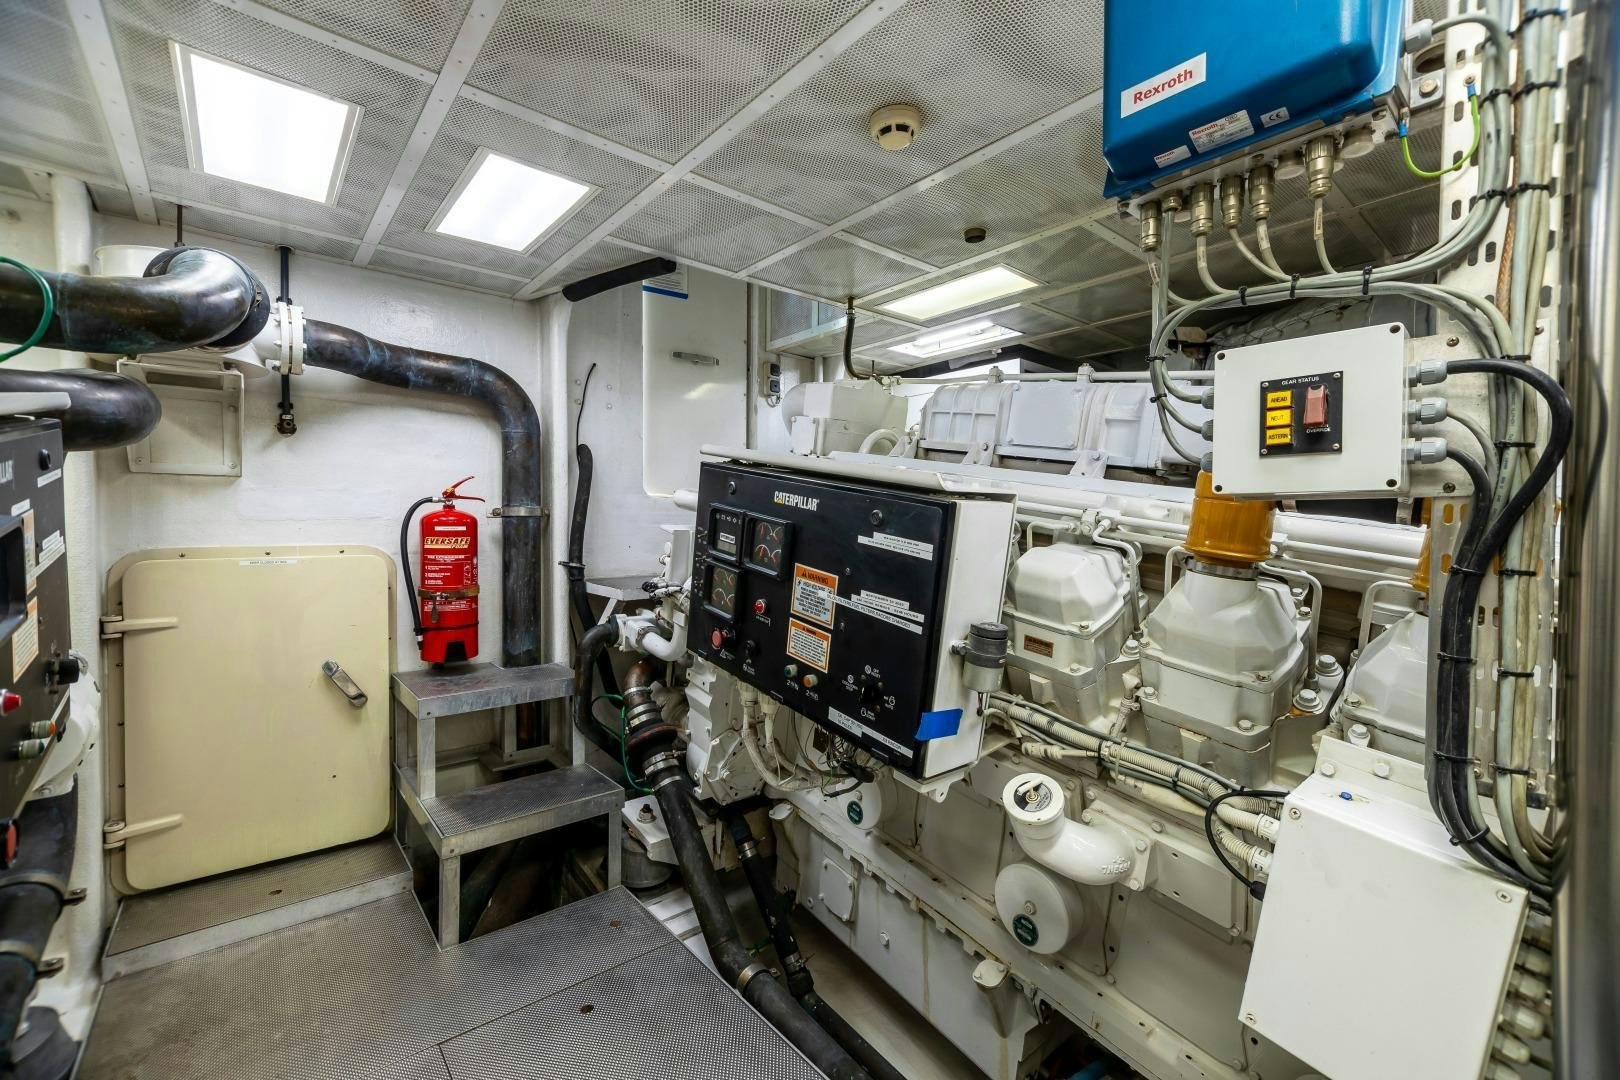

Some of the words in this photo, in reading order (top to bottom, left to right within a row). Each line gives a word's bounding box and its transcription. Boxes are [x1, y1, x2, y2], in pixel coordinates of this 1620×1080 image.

[1133, 68, 1193, 105] Rexroth
[1192, 122, 1218, 137] Rexroth
[1298, 376, 1320, 384] STATUS
[774, 490, 819, 512] CATERPILLAR
[424, 536, 471, 546] EVERSAFE
